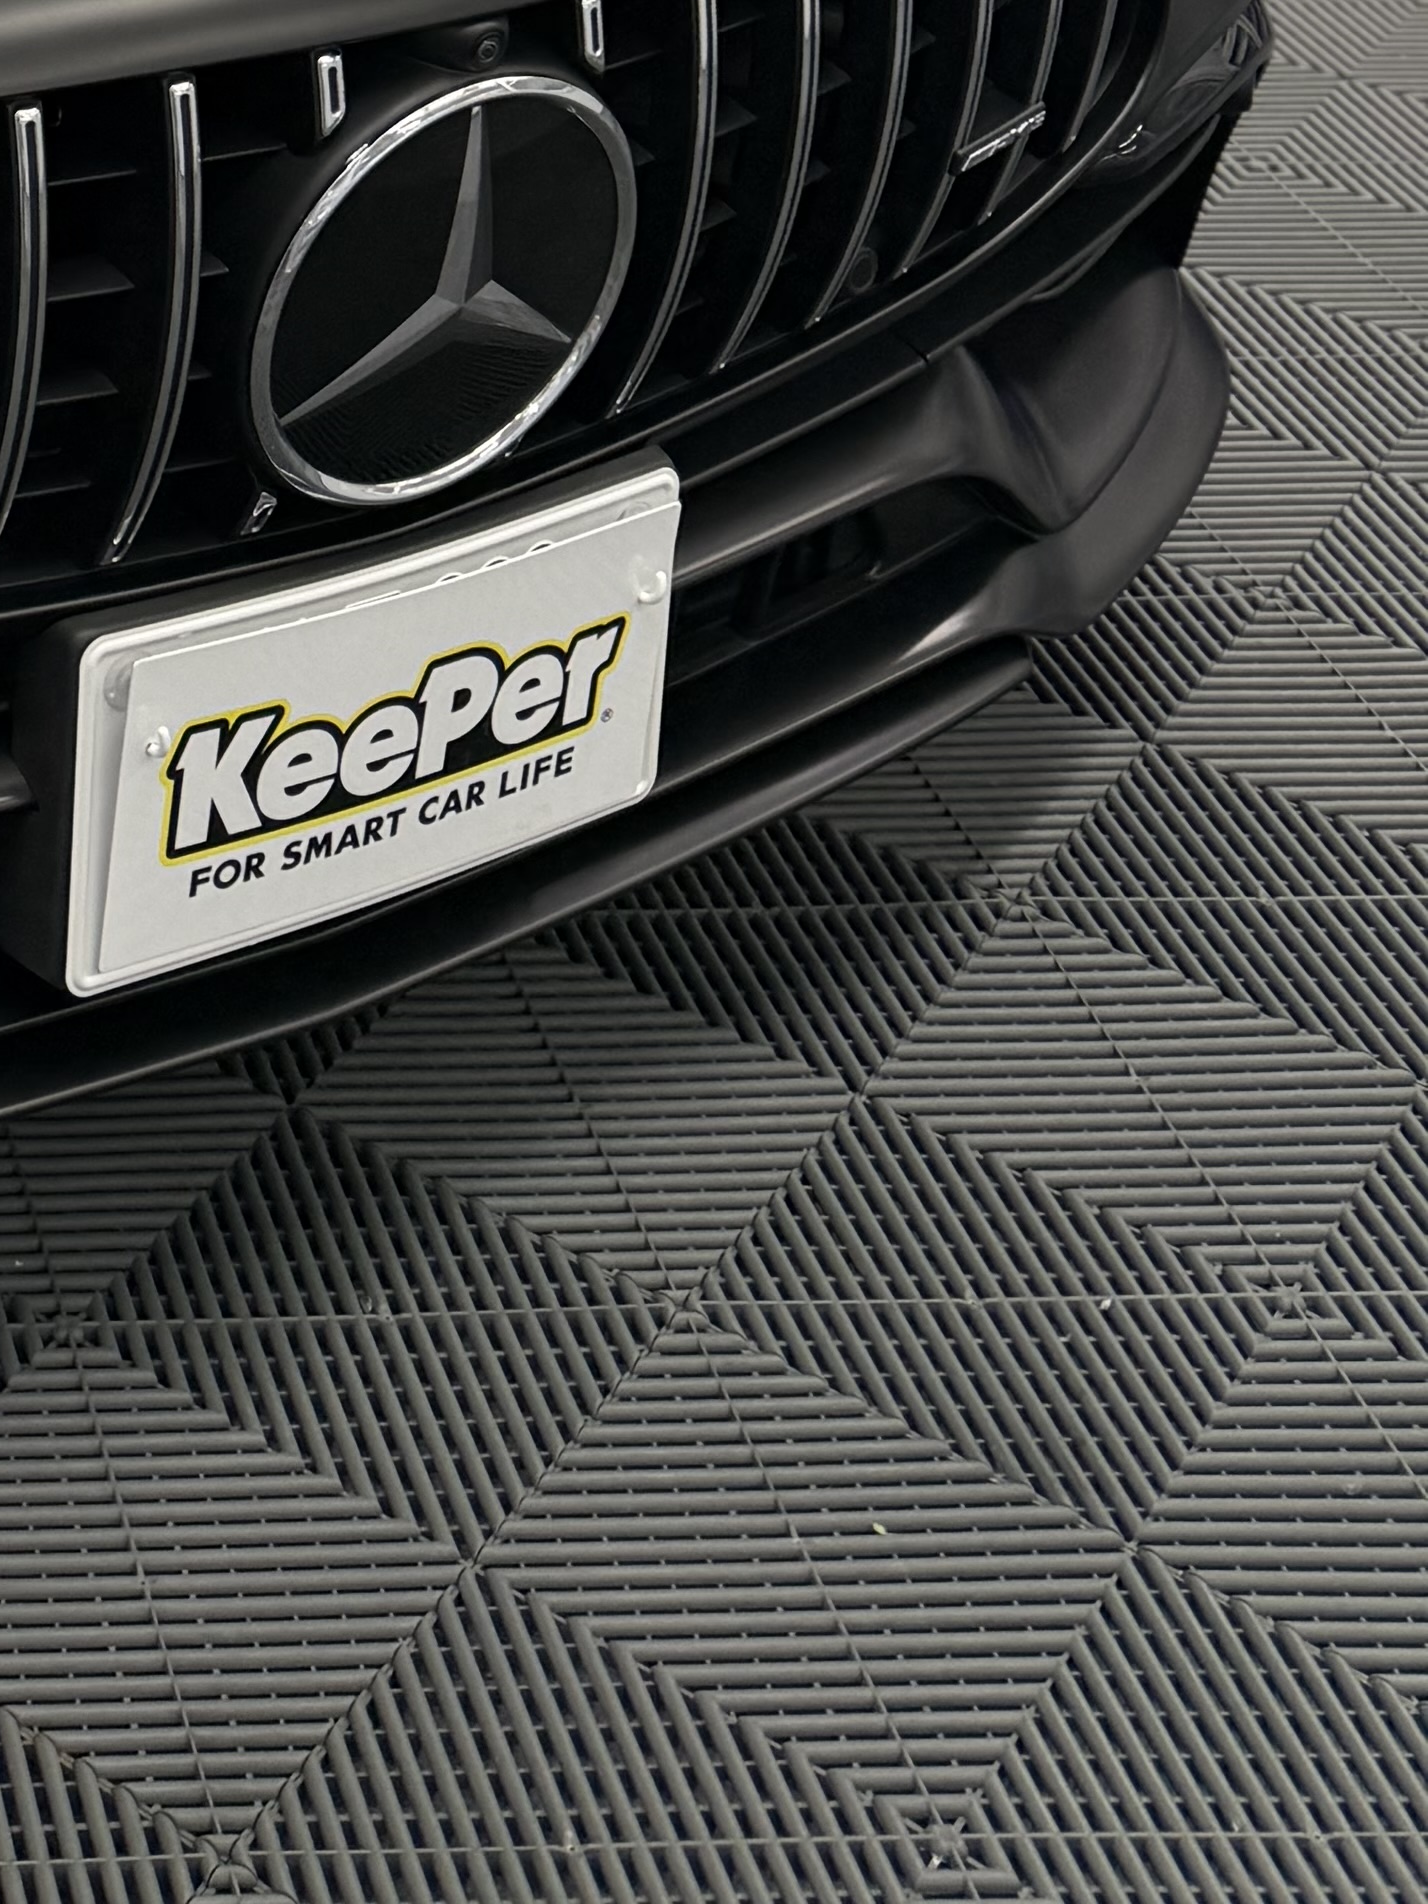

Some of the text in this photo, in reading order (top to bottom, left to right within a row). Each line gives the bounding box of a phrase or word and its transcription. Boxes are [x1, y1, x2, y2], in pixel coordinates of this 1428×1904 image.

[165, 615, 627, 860] KeePer
[189, 747, 576, 898] FOR SMART CAR LIFE
